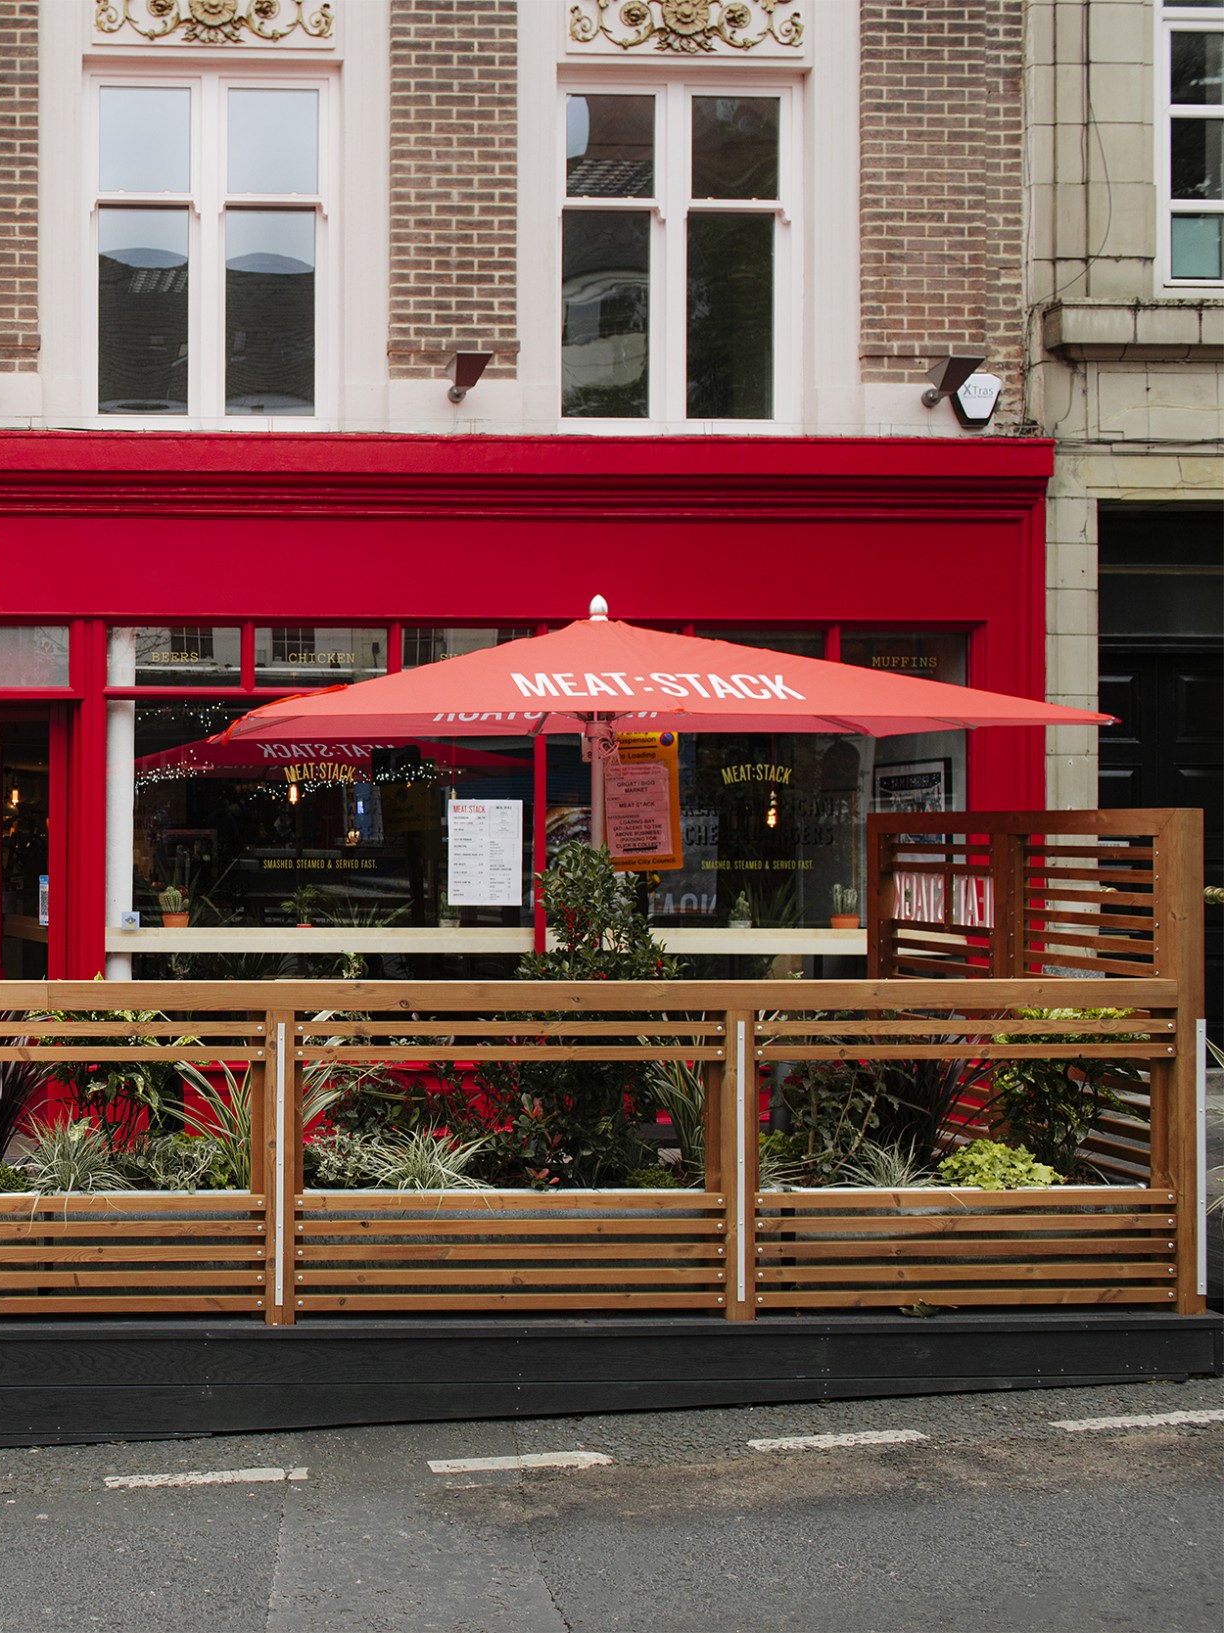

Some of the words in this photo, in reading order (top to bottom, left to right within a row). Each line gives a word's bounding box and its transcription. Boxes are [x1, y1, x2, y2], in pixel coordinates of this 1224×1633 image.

[151, 651, 199, 663] BEERS
[288, 652, 356, 664] CHICKEN
[872, 656, 938, 668] MUFFINS
[510, 672, 807, 701] MEAT:STACK
[628, 751, 656, 760] Loading
[284, 762, 356, 784] MEAT:STACK
[721, 763, 792, 785] MEAT:STACK
[296, 858, 325, 869] STEAMED
[327, 859, 333, 869] &
[335, 858, 359, 869] SERVED
[361, 858, 378, 869] FAST.
[637, 858, 650, 866] City
[652, 857, 676, 865] Council
[733, 860, 763, 870] STEAMED
[764, 860, 770, 870] &
[772, 860, 796, 870] SERVED
[797, 860, 815, 870] FAST.
